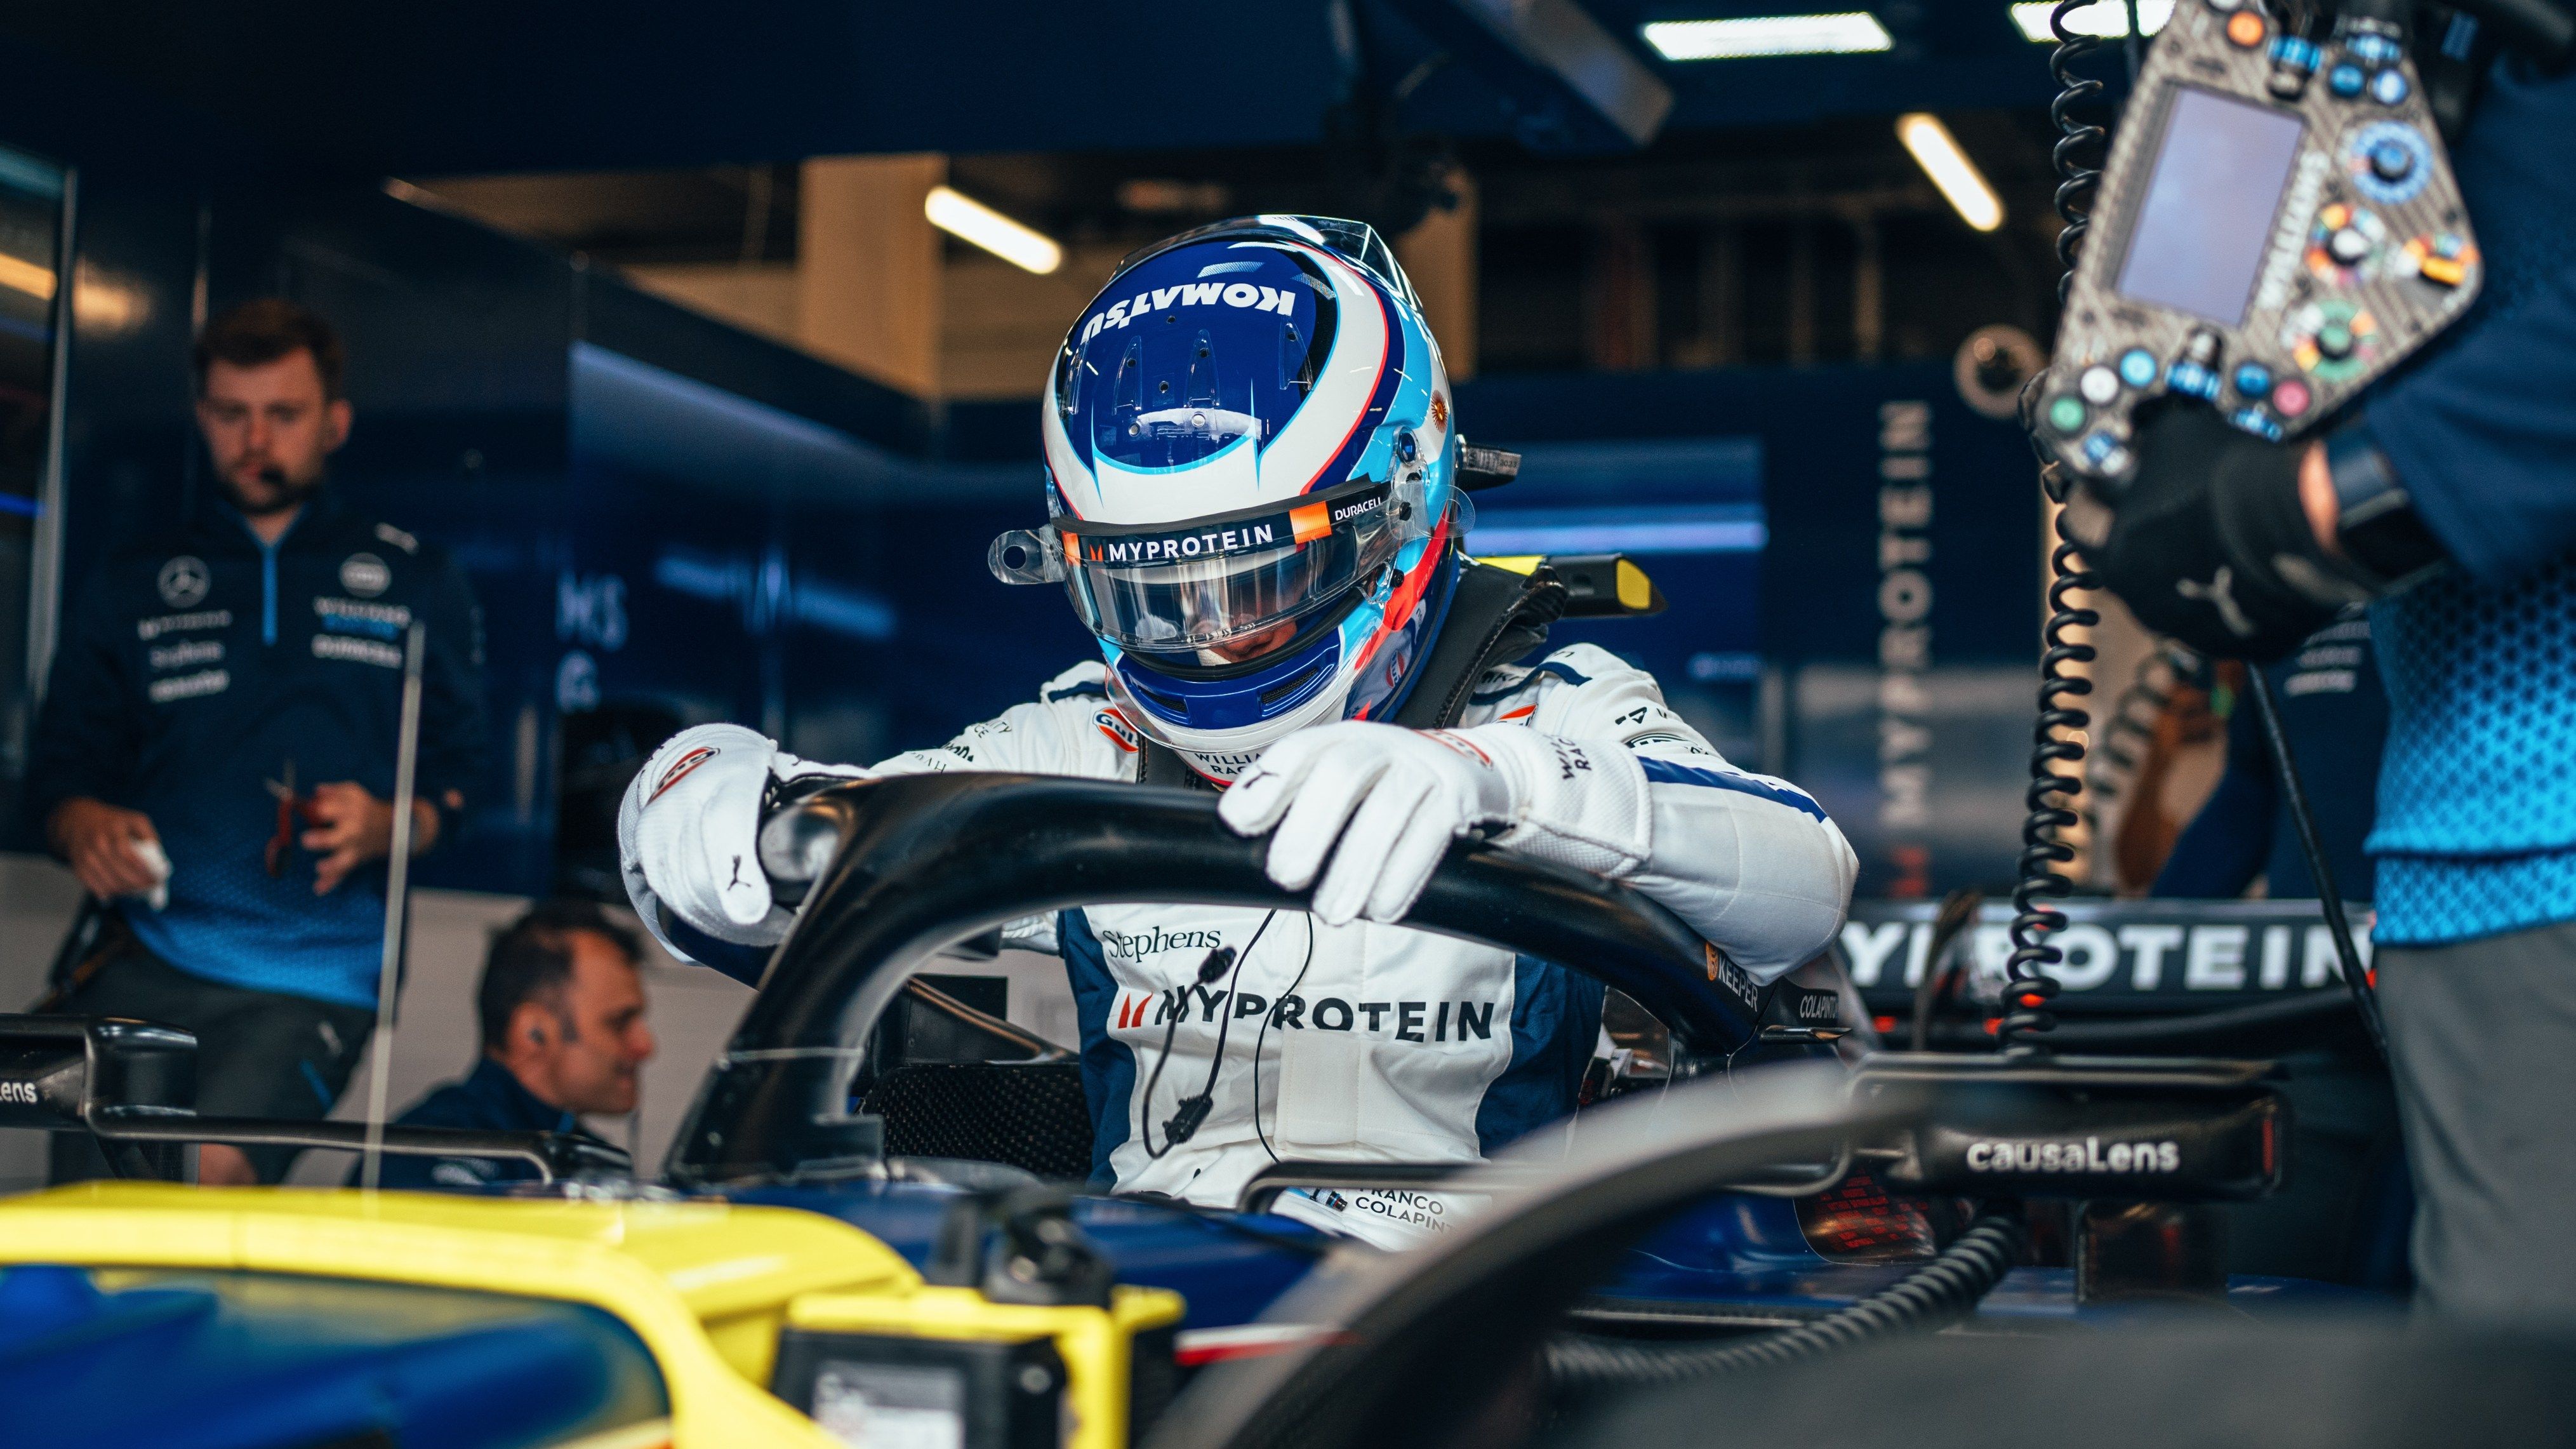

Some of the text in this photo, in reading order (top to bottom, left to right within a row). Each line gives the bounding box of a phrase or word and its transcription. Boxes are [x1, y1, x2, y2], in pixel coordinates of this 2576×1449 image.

[1080, 283, 1296, 345] KOMATSU
[1108, 524, 1273, 562] MYPROTEIN
[1877, 400, 1934, 828] MYPROTEIN
[1103, 926, 1221, 964] Stephens
[1718, 952, 1758, 1013] KEEPER
[1154, 984, 1494, 1043] MYPROTEIN
[1967, 1136, 2180, 1173] causaLens
[1360, 1189, 1444, 1216] RANCO
